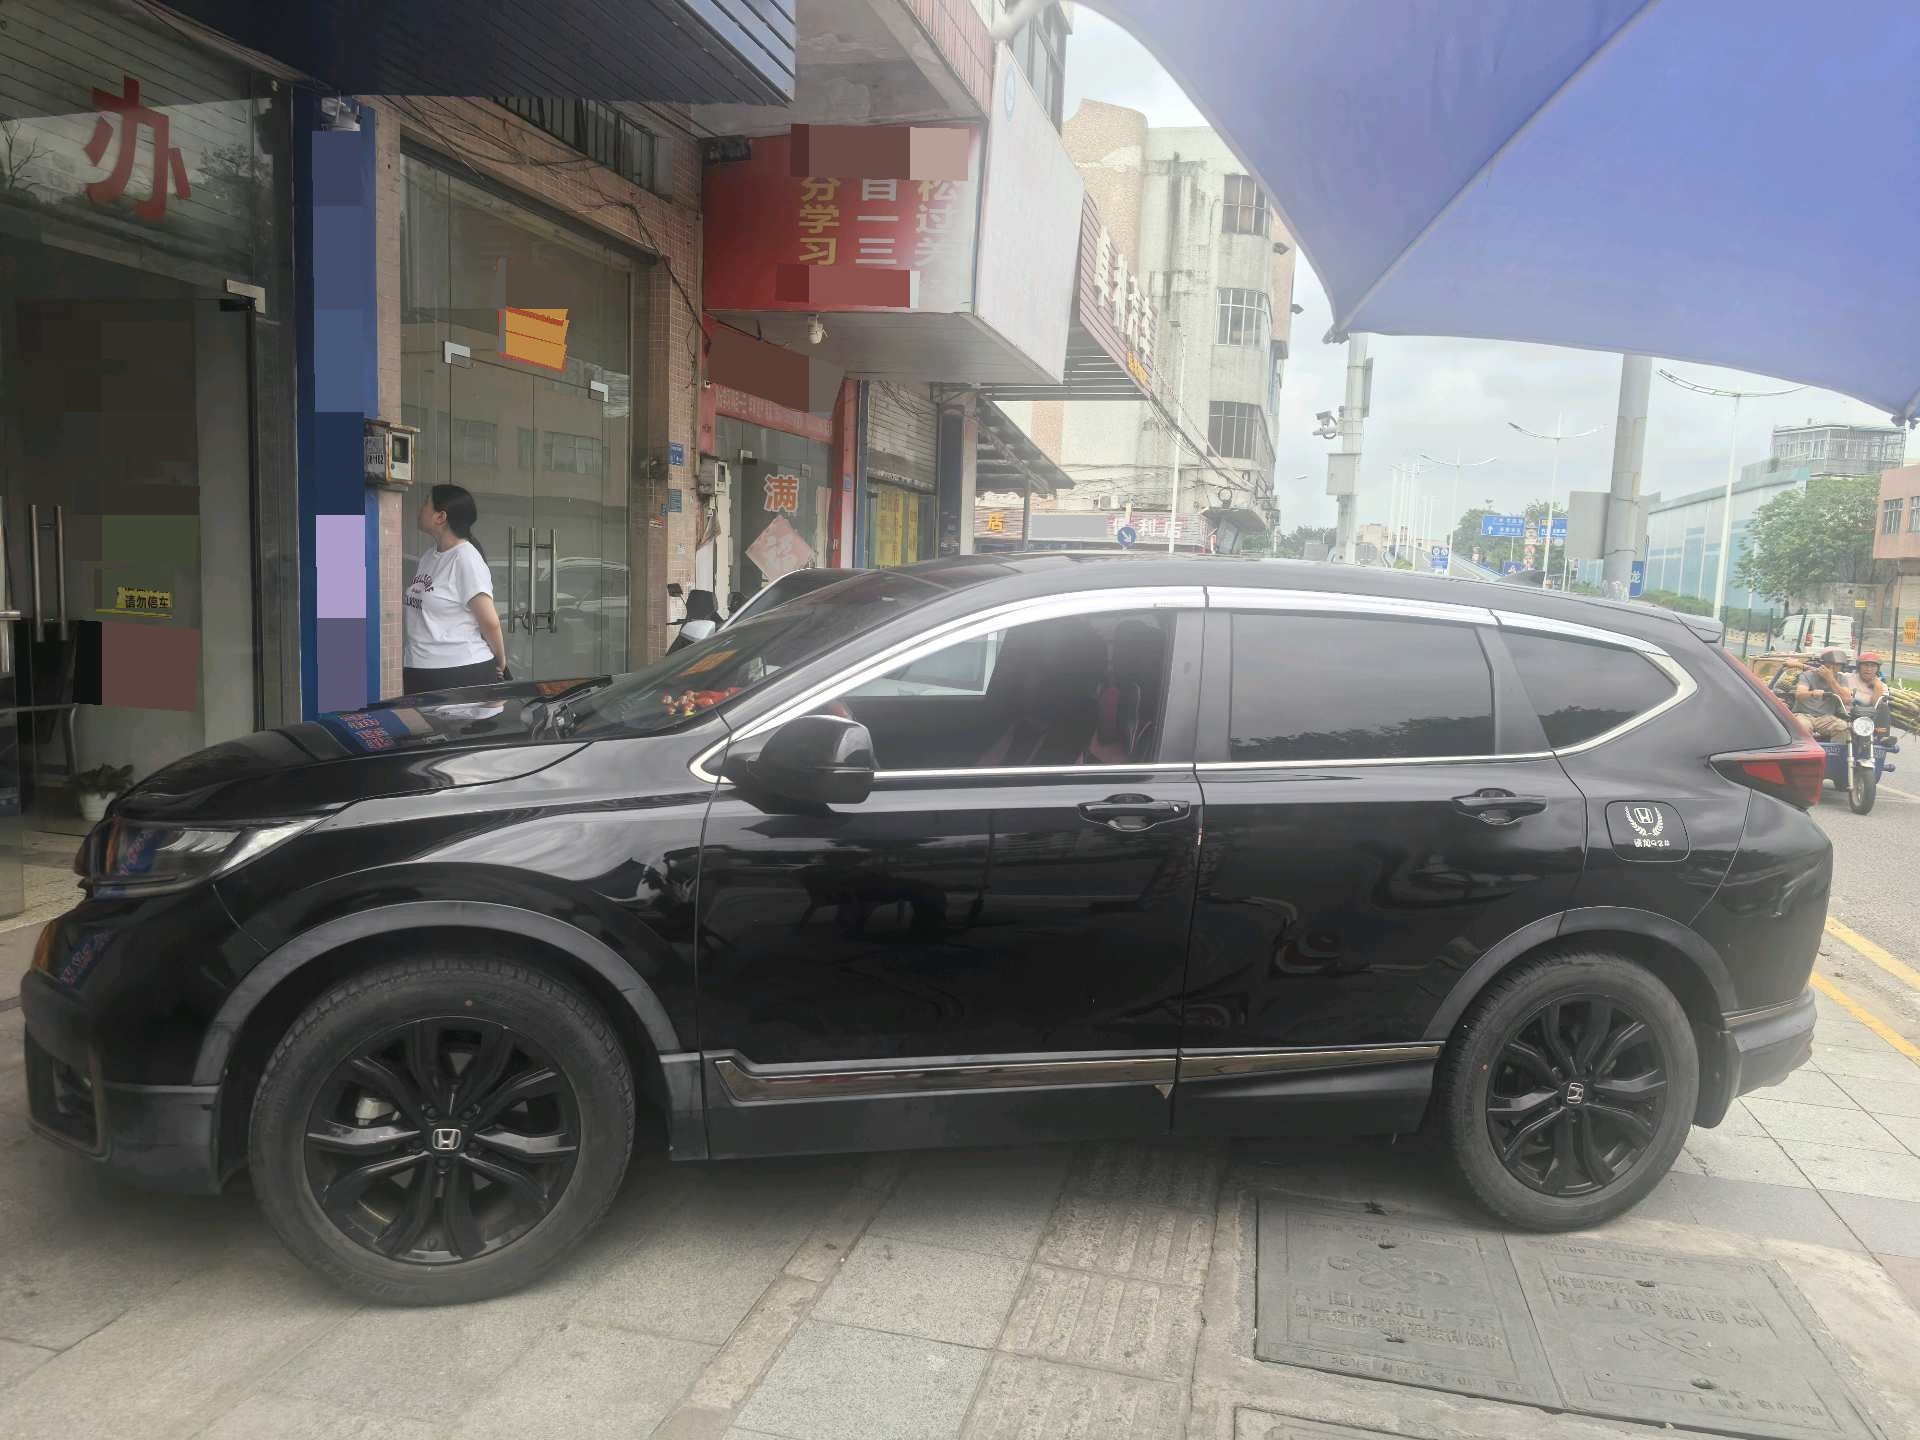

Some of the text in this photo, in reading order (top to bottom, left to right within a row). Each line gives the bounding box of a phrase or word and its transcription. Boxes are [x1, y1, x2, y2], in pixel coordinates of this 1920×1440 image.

[84, 75, 192, 220] 办
[764, 474, 800, 513] 满
[125, 595, 169, 609] 请勿停车
